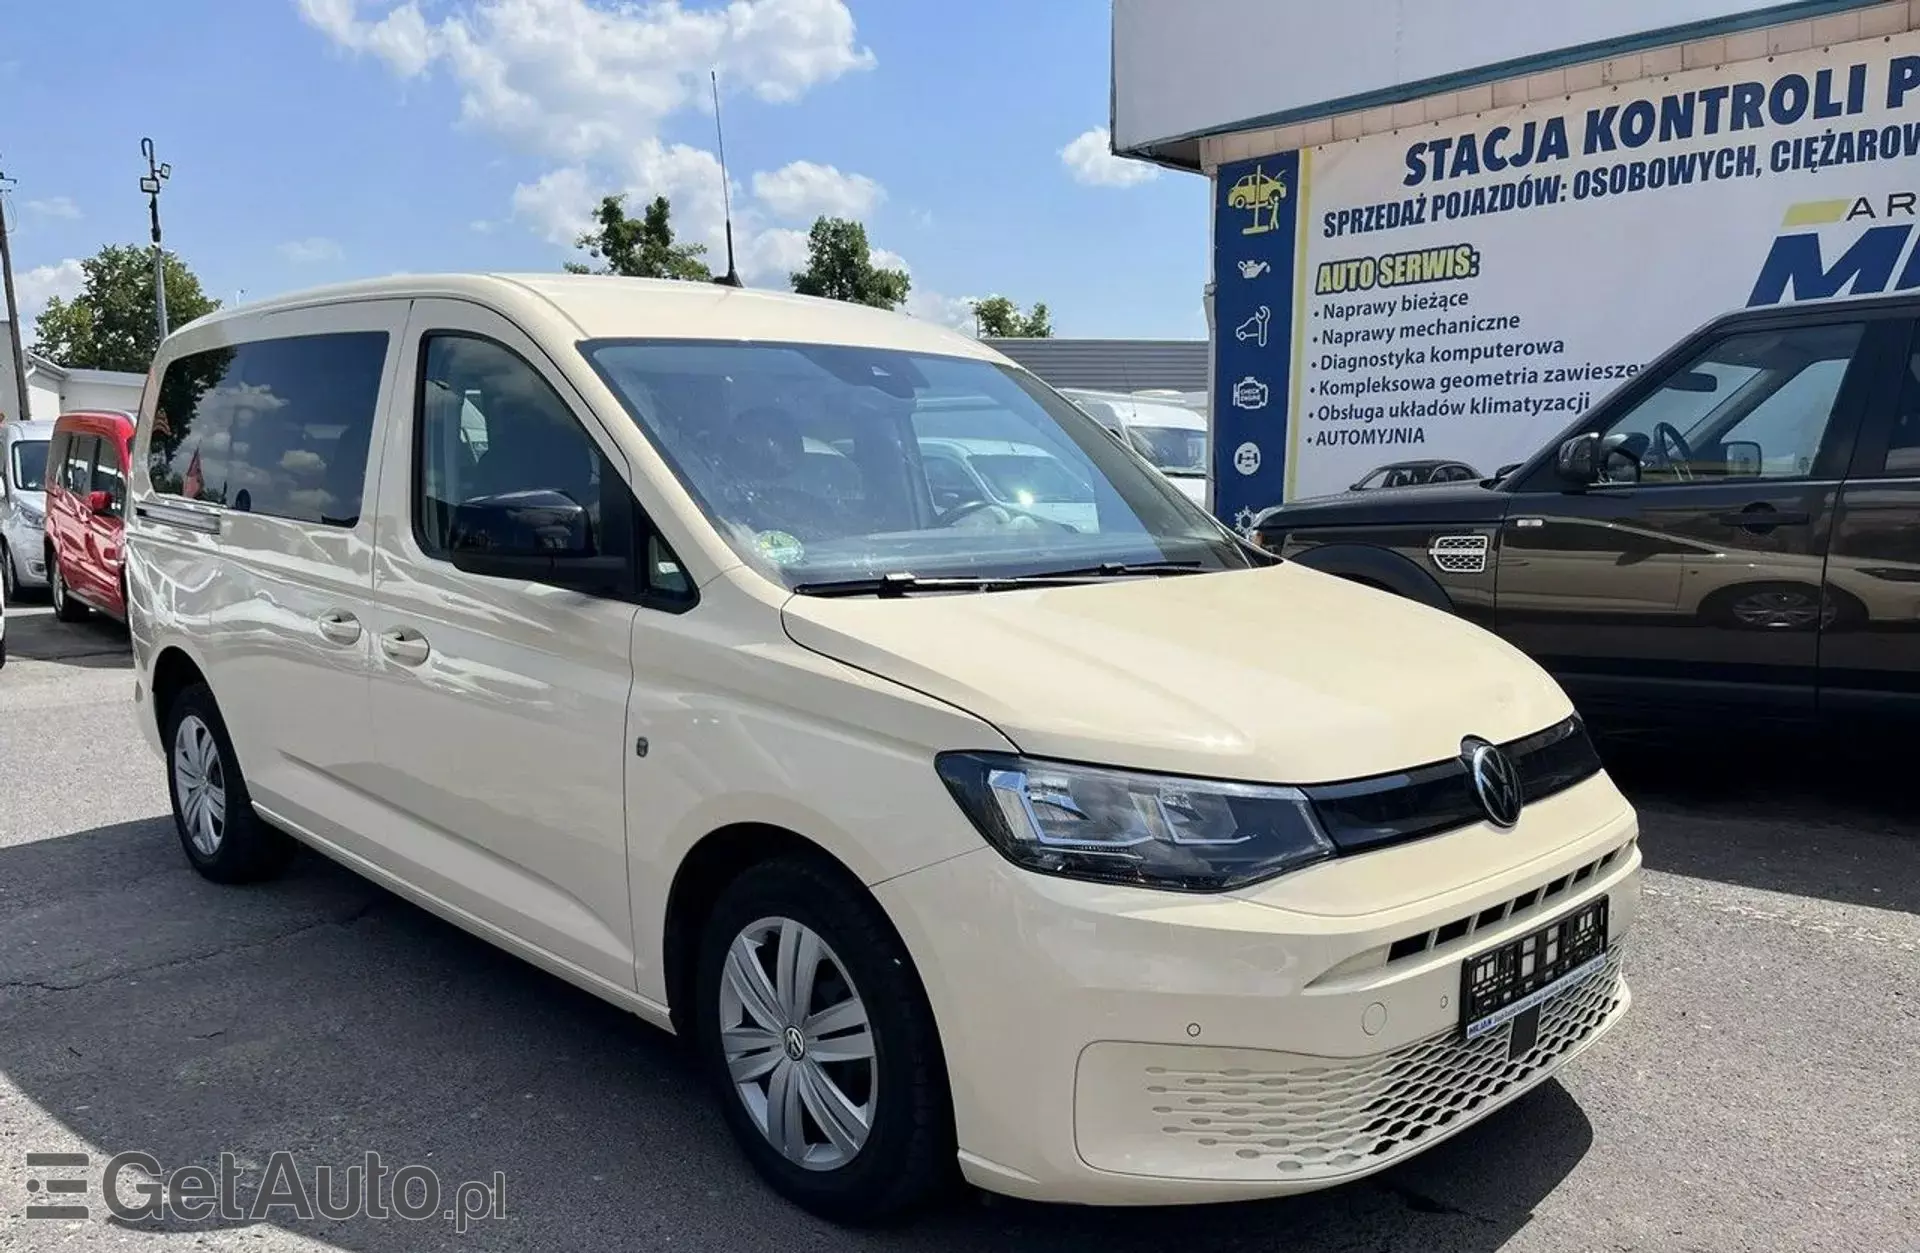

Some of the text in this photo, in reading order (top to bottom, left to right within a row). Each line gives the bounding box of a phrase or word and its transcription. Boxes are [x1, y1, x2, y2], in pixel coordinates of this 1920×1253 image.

[1403, 117, 1569, 186] STACJA
[1583, 63, 1867, 155] KONTROLI
[1323, 193, 1426, 238] SPRZEDAŻ
[1431, 174, 1567, 222] POJAZDÓW:
[1573, 145, 1762, 200] OSOBOWYCH,
[1315, 243, 1480, 295] AUTO SERWIS:
[1323, 292, 1469, 321] Naprawy bieżące
[1322, 315, 1521, 347] Naprawy mechaniczne
[1320, 340, 1565, 372] Diagnostyka komputerowa
[1319, 362, 1645, 397] Kompleksowa geometria zawiesze
[1318, 392, 1591, 423] Obsługa układów klimatyzacji
[1316, 427, 1425, 447] AUTOMYJNIA
